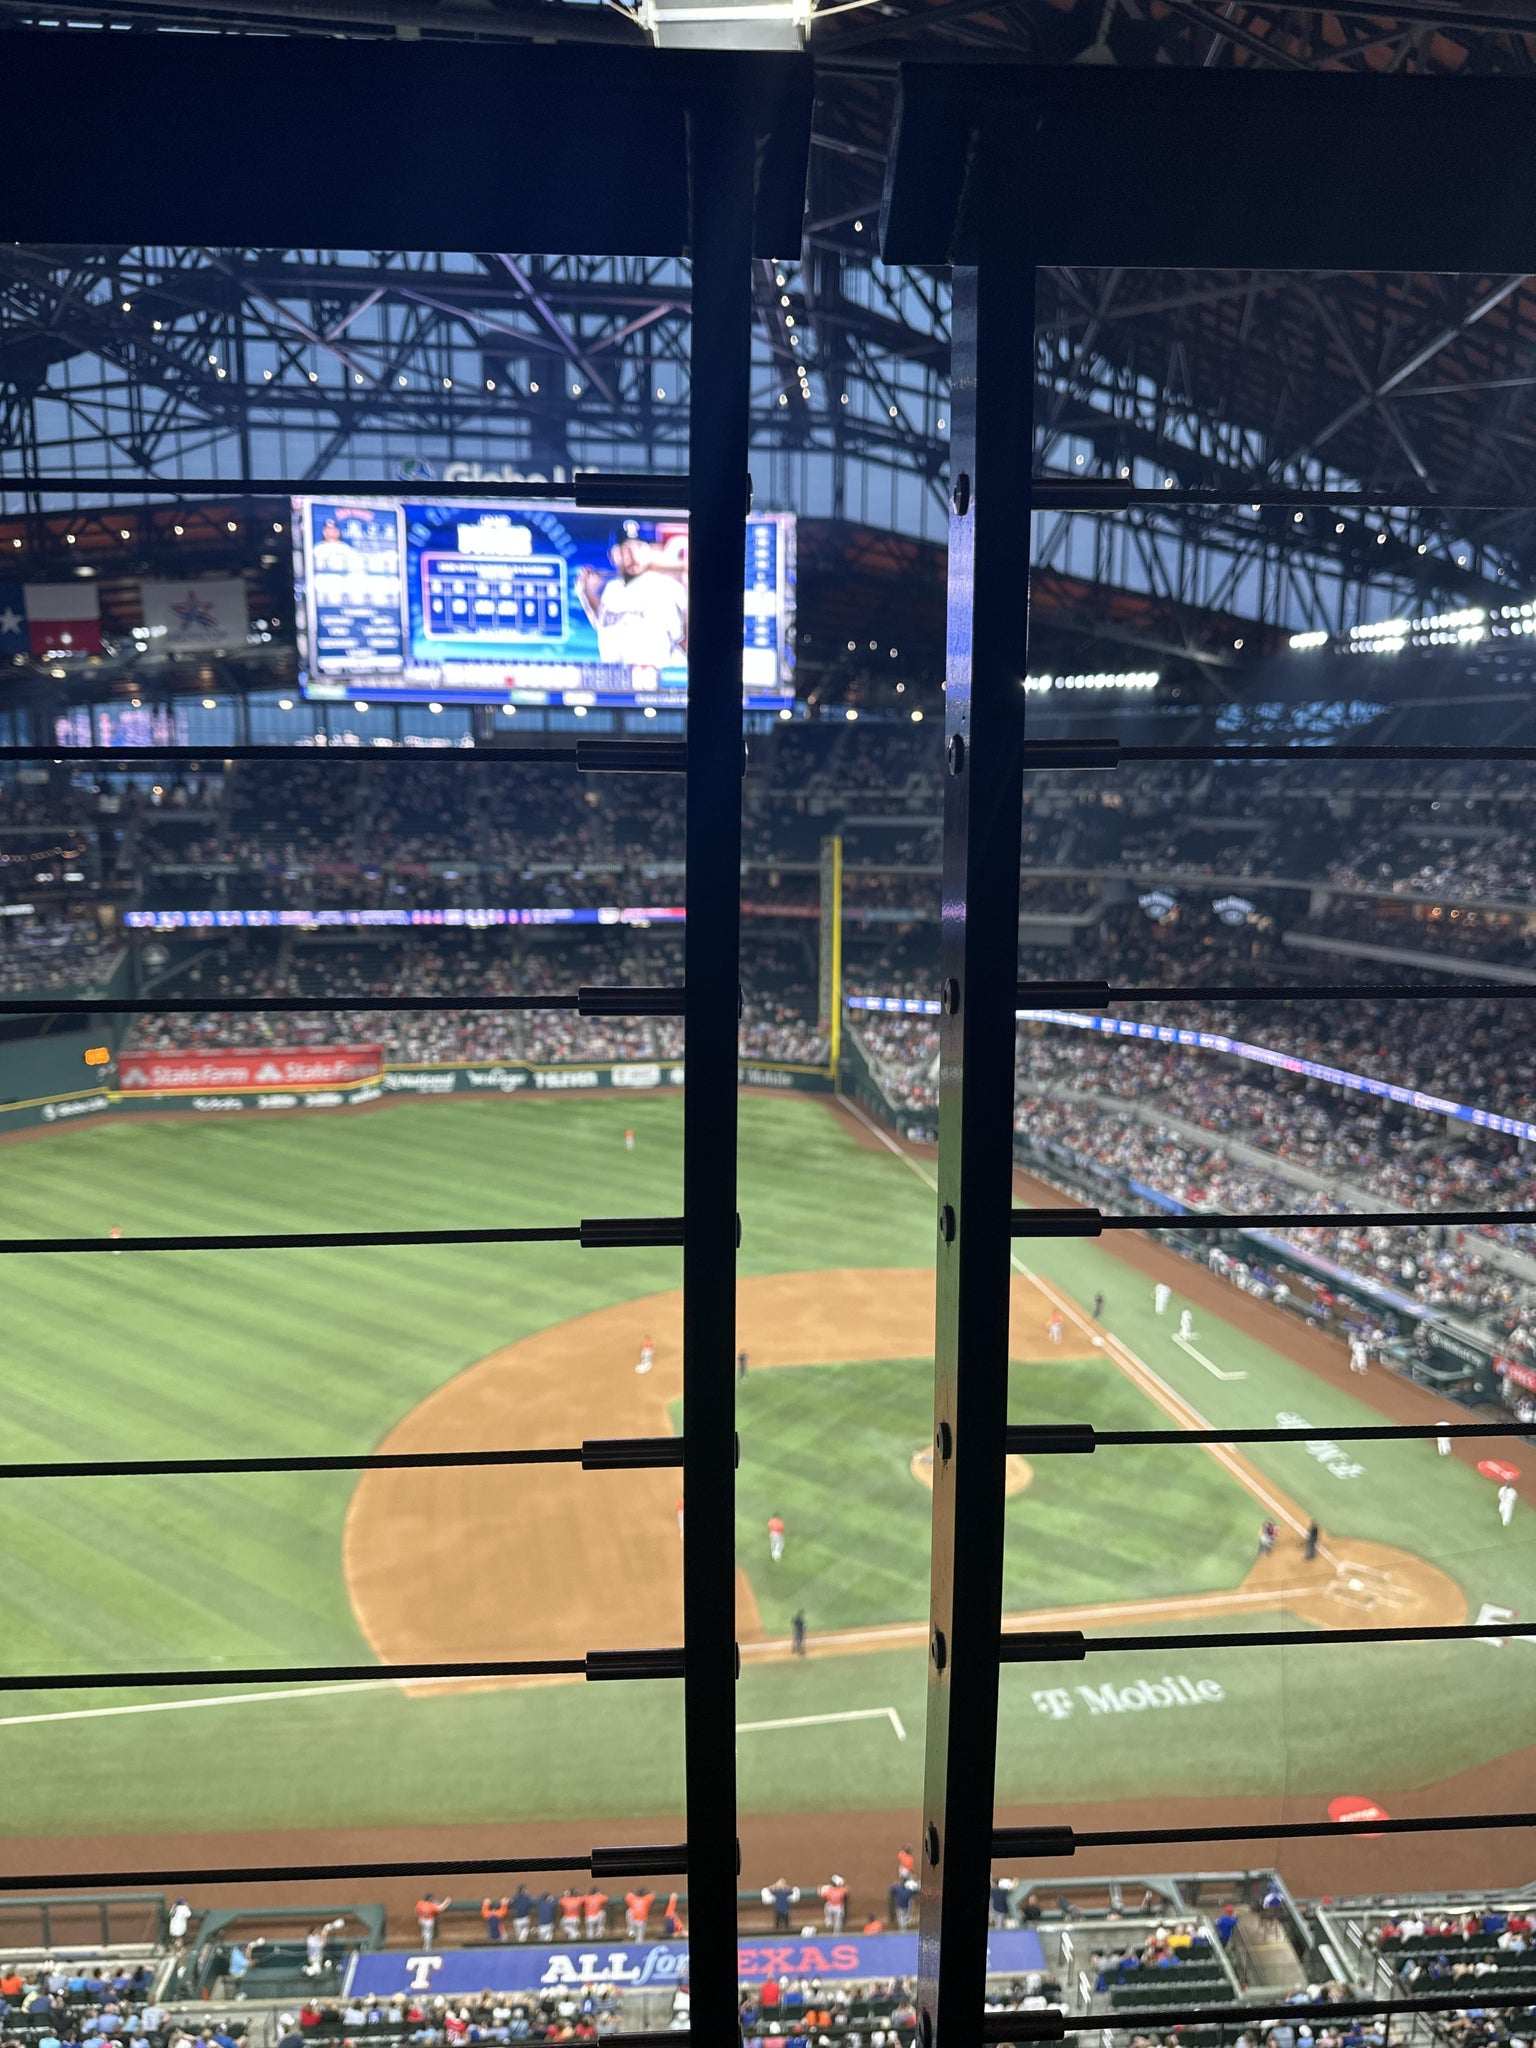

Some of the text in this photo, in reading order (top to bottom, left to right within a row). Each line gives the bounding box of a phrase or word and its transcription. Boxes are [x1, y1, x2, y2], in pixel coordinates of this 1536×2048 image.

[150, 1064, 249, 1085] State Farm
[1078, 1675, 1226, 1716] Mobile
[405, 1955, 444, 1990] T
[541, 1952, 641, 1984] ALL
[738, 1944, 860, 1974] EXAS
